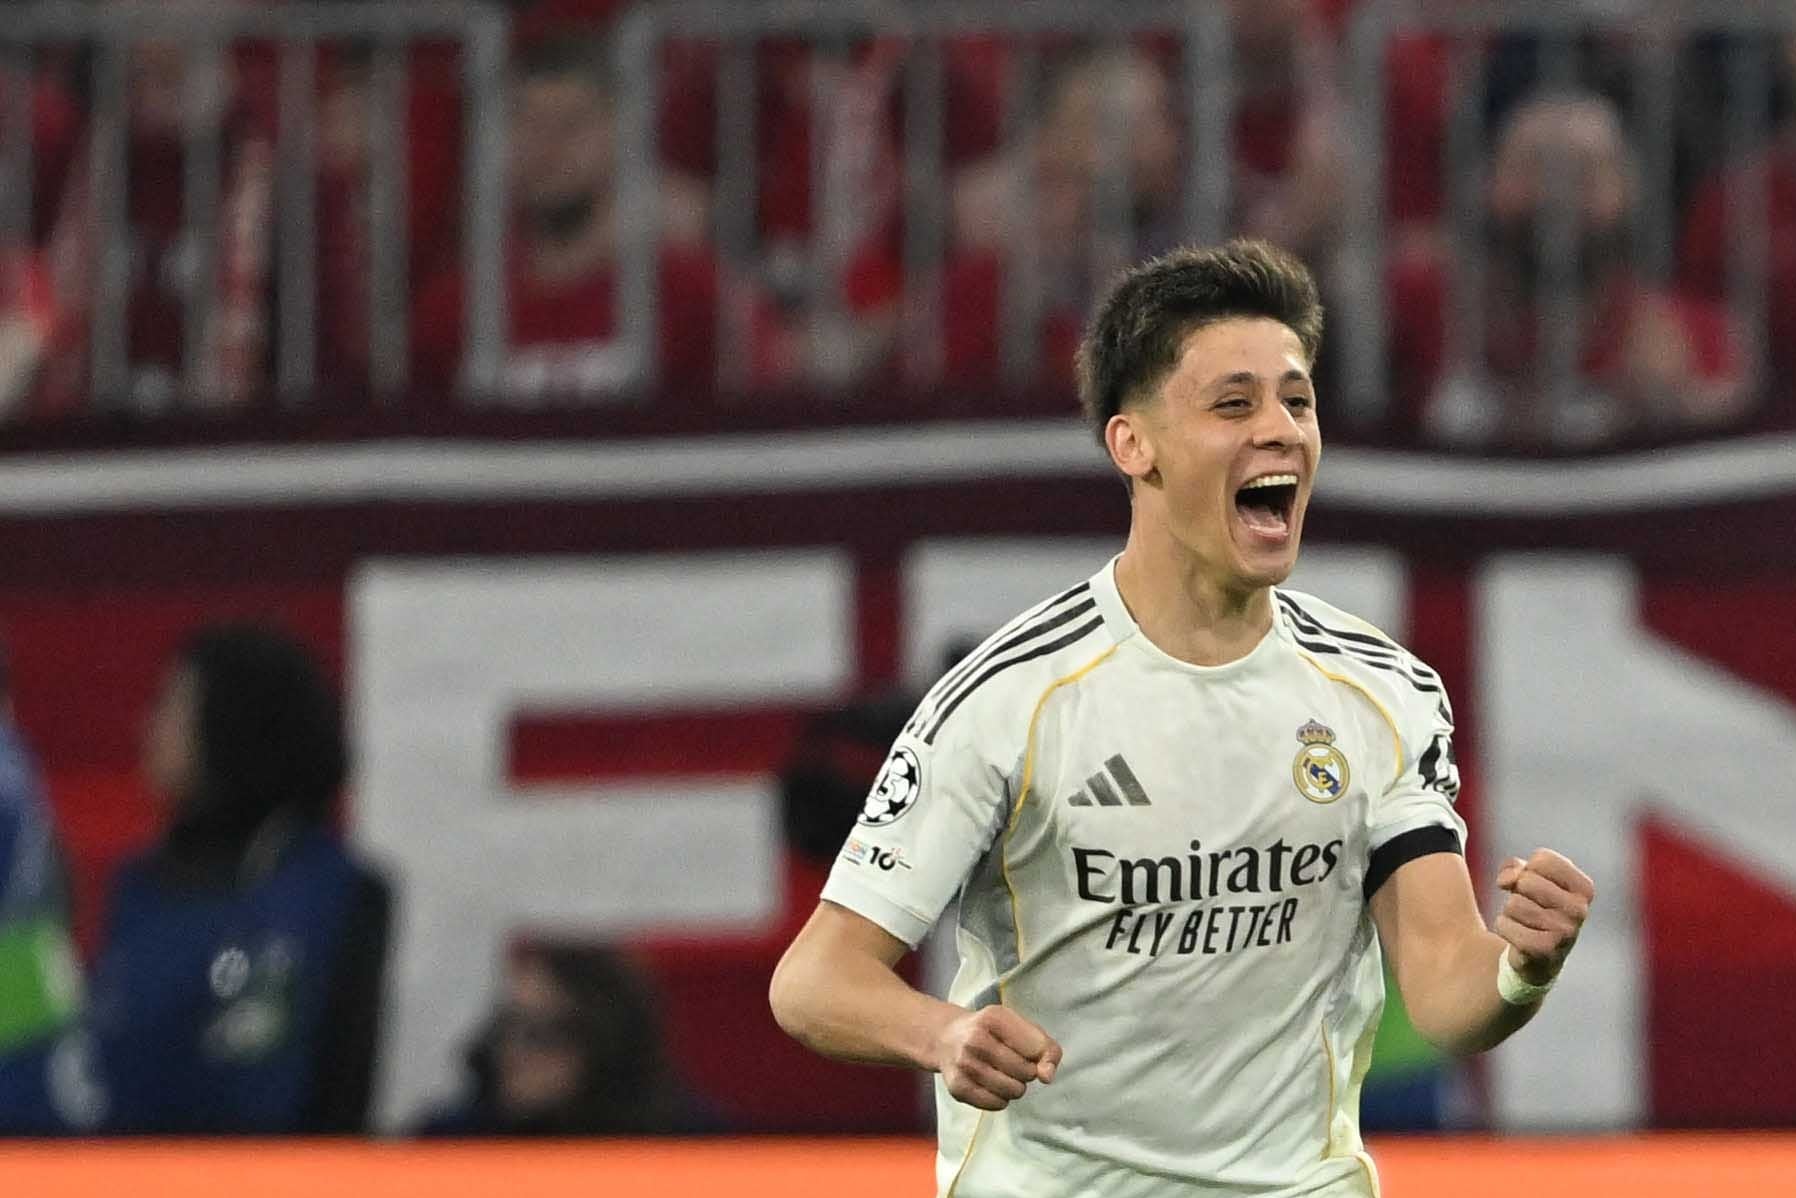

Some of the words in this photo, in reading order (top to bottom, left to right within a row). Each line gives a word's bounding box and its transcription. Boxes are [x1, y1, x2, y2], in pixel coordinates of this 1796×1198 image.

[1071, 838, 1343, 905] Emirates
[1105, 907, 1175, 957] FLY
[1177, 898, 1299, 955] BETTER
